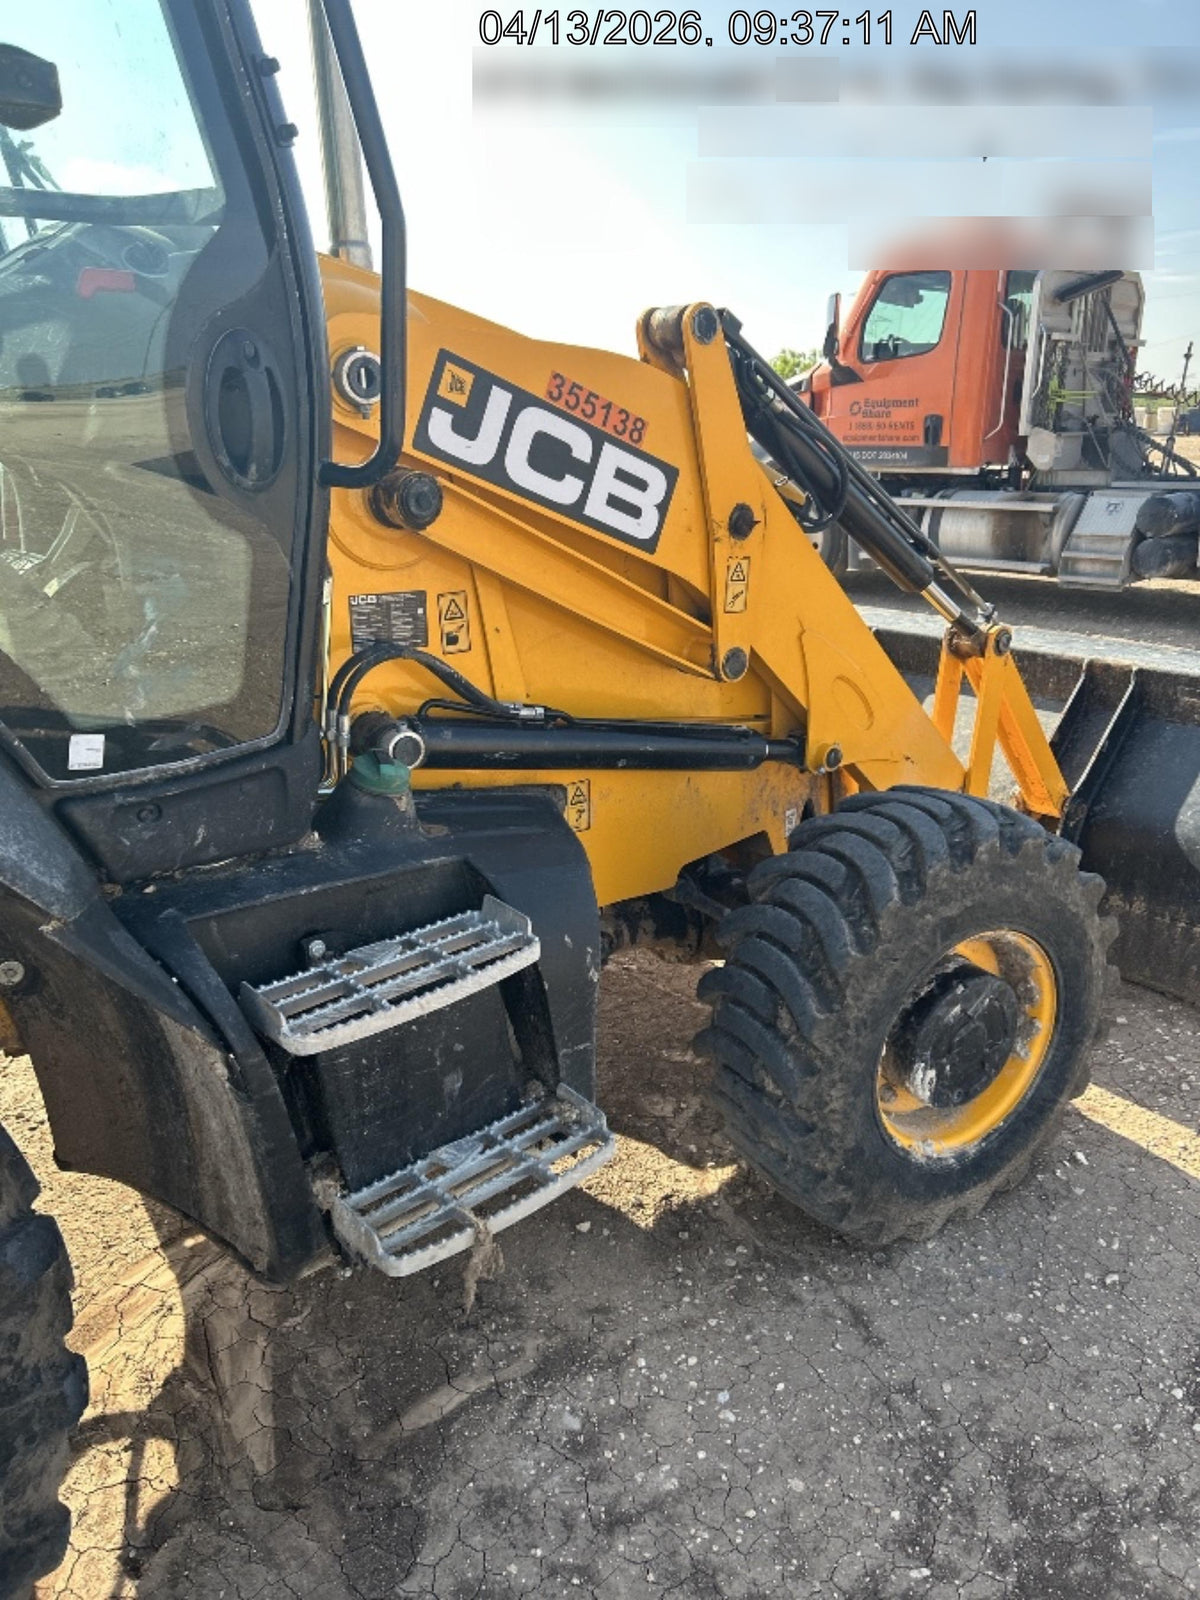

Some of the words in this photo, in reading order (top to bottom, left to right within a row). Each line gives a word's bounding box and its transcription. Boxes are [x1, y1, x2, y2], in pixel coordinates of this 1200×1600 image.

[548, 372, 646, 445] 355138
[863, 398, 919, 409] Equipment
[862, 410, 892, 418] Share
[428, 384, 668, 540] JCB
[350, 595, 377, 605] JCB
